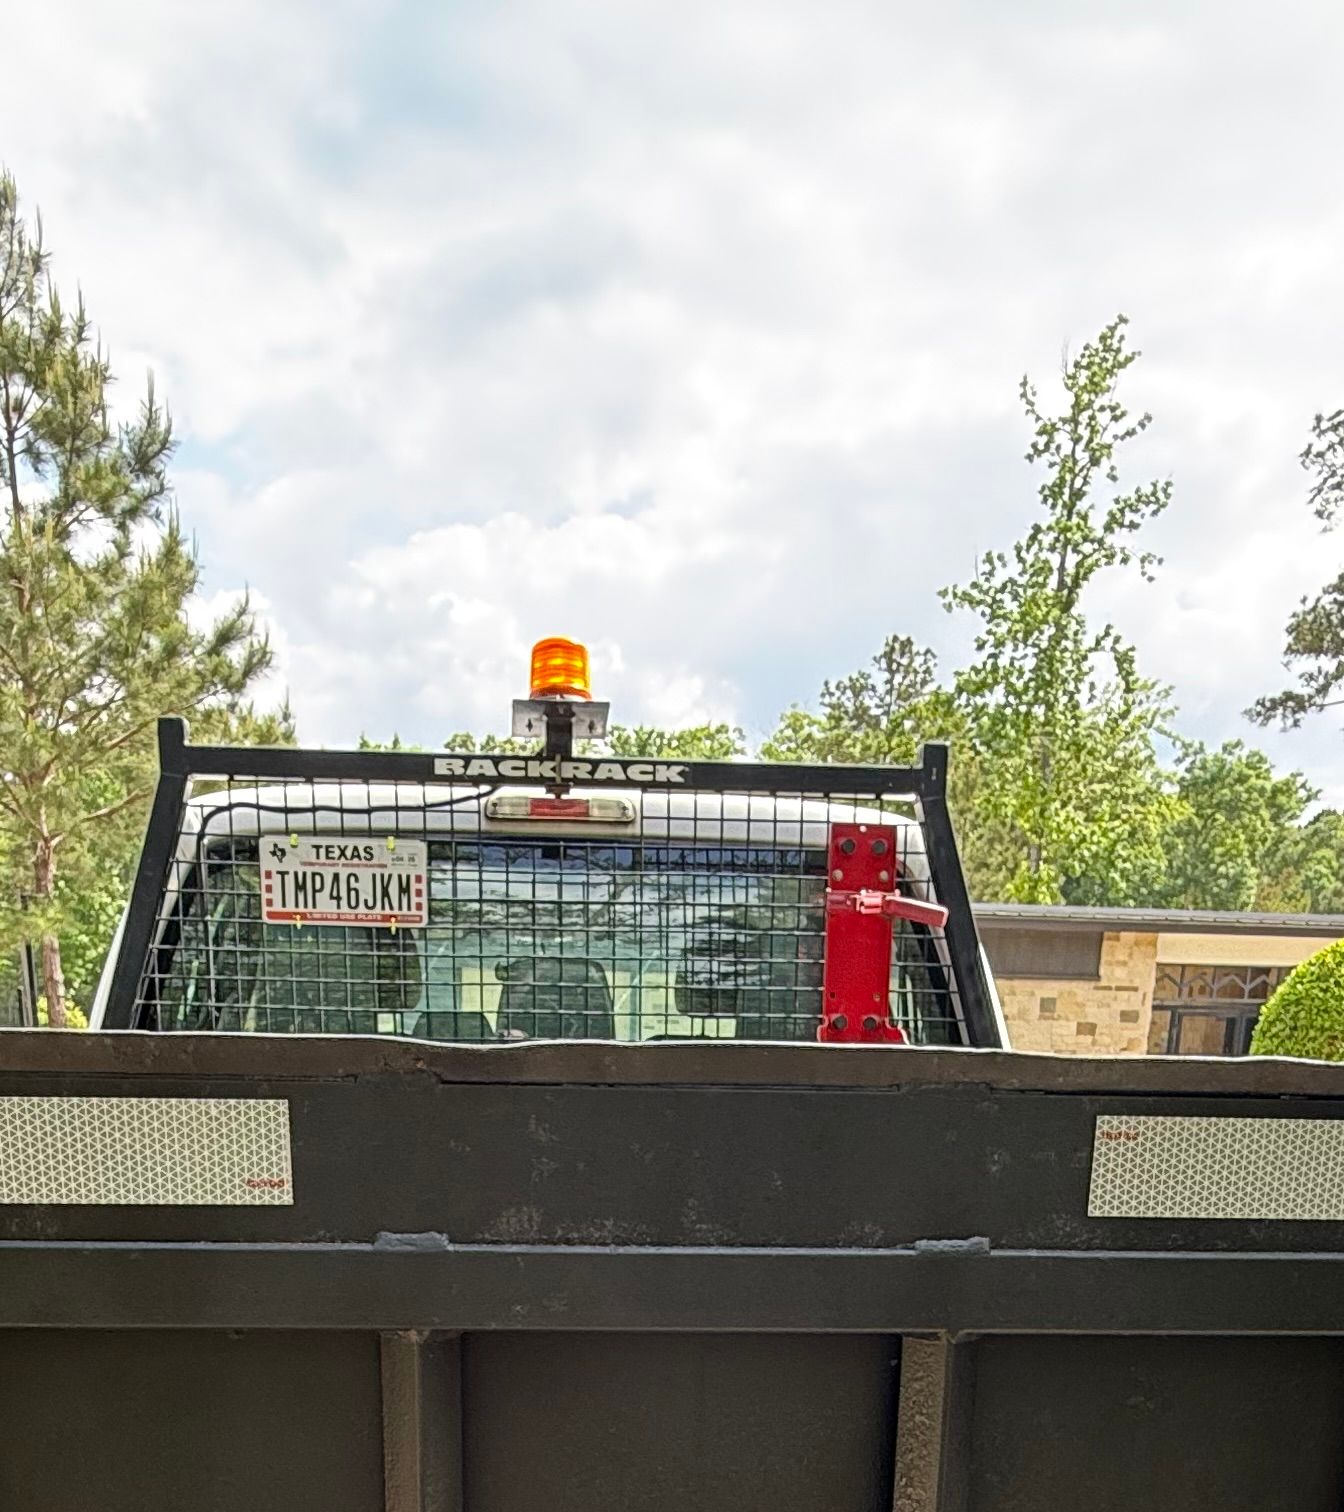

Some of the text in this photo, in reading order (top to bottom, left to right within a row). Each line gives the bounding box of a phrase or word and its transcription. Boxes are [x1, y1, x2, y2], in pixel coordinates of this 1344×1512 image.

[434, 757, 686, 783] BACKRACK
[311, 845, 375, 862] TEXAS
[276, 870, 412, 912] TMP46JKM
